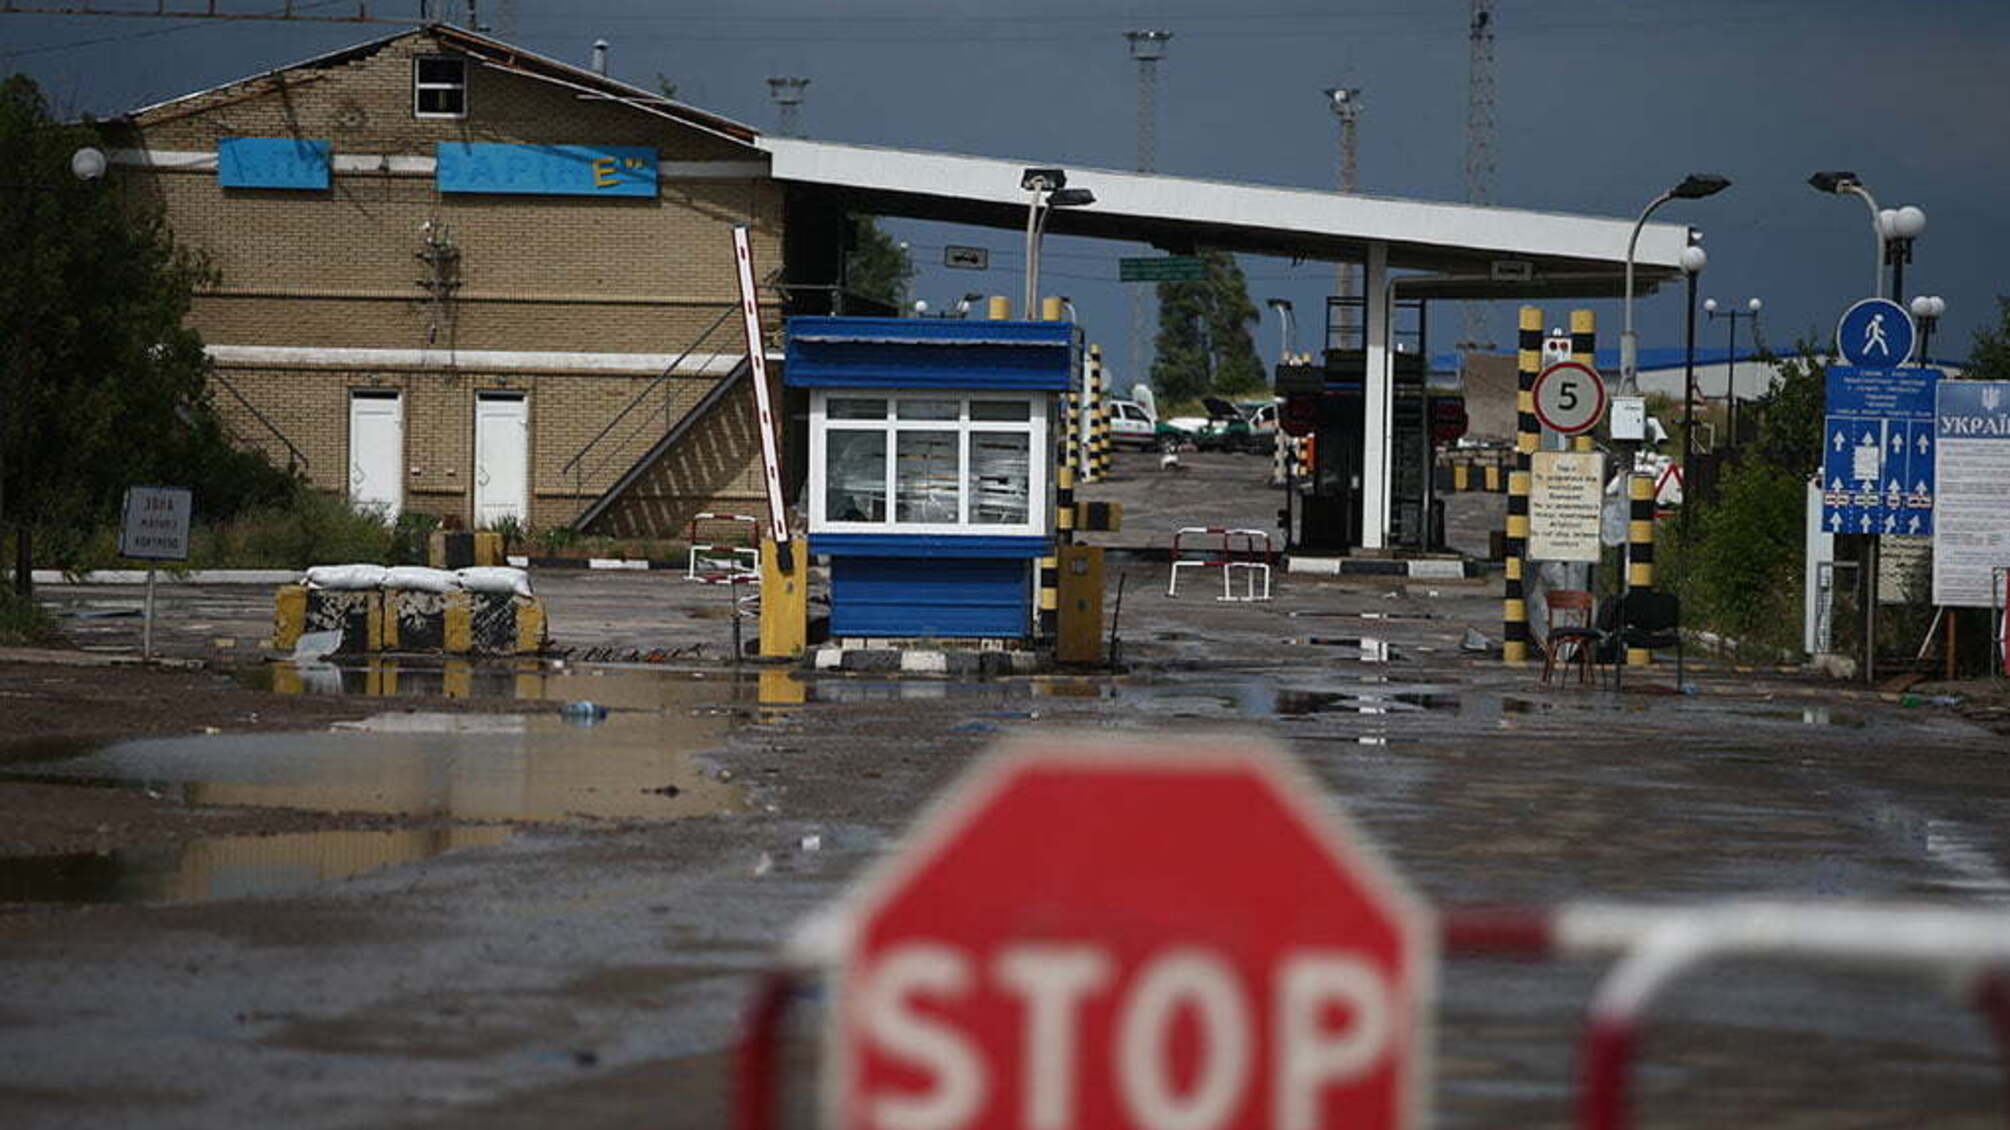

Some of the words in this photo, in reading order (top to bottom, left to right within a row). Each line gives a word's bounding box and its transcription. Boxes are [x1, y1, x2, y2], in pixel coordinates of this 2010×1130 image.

[1558, 381, 1578, 411] 5
[1941, 413, 2010, 435] УКРАЇ
[865, 944, 1398, 1130] STOP
